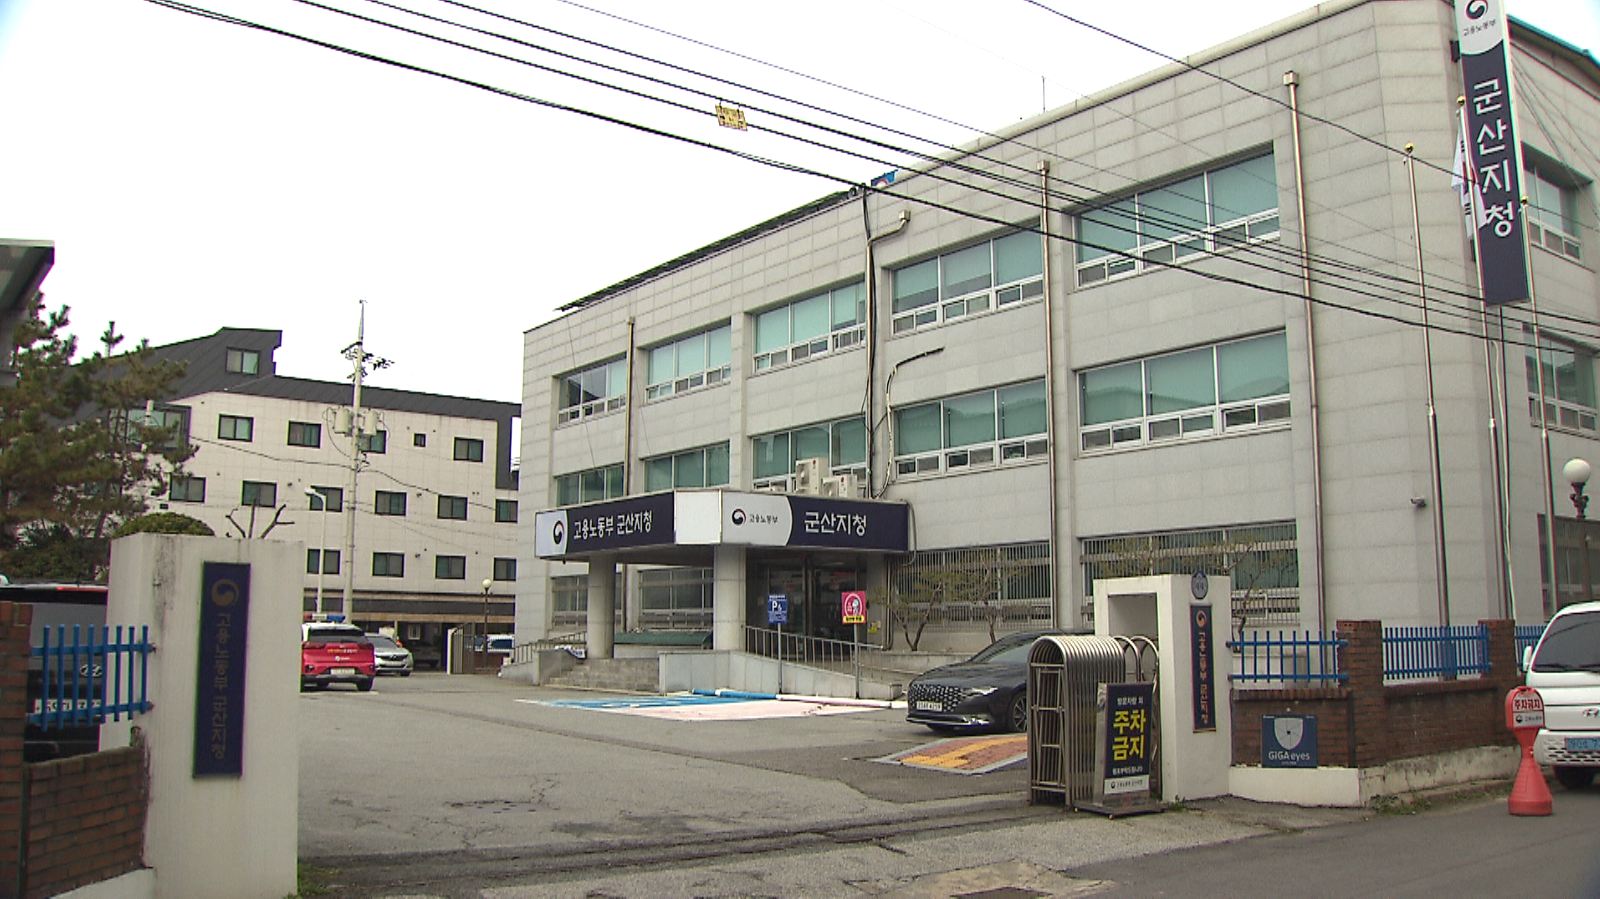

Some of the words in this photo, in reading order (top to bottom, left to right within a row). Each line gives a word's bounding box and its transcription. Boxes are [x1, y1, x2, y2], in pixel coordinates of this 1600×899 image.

[1473, 77, 1515, 238] 군산지청
[573, 515, 614, 541] 고용노동부
[616, 509, 653, 534] 군산지청
[804, 511, 868, 537] 군산지청
[214, 613, 231, 692] 고용노동부
[211, 695, 228, 760] 군산지청
[1113, 708, 1146, 734] 주차
[1112, 734, 1145, 761] 금지
[1290, 752, 1311, 763] eyes
